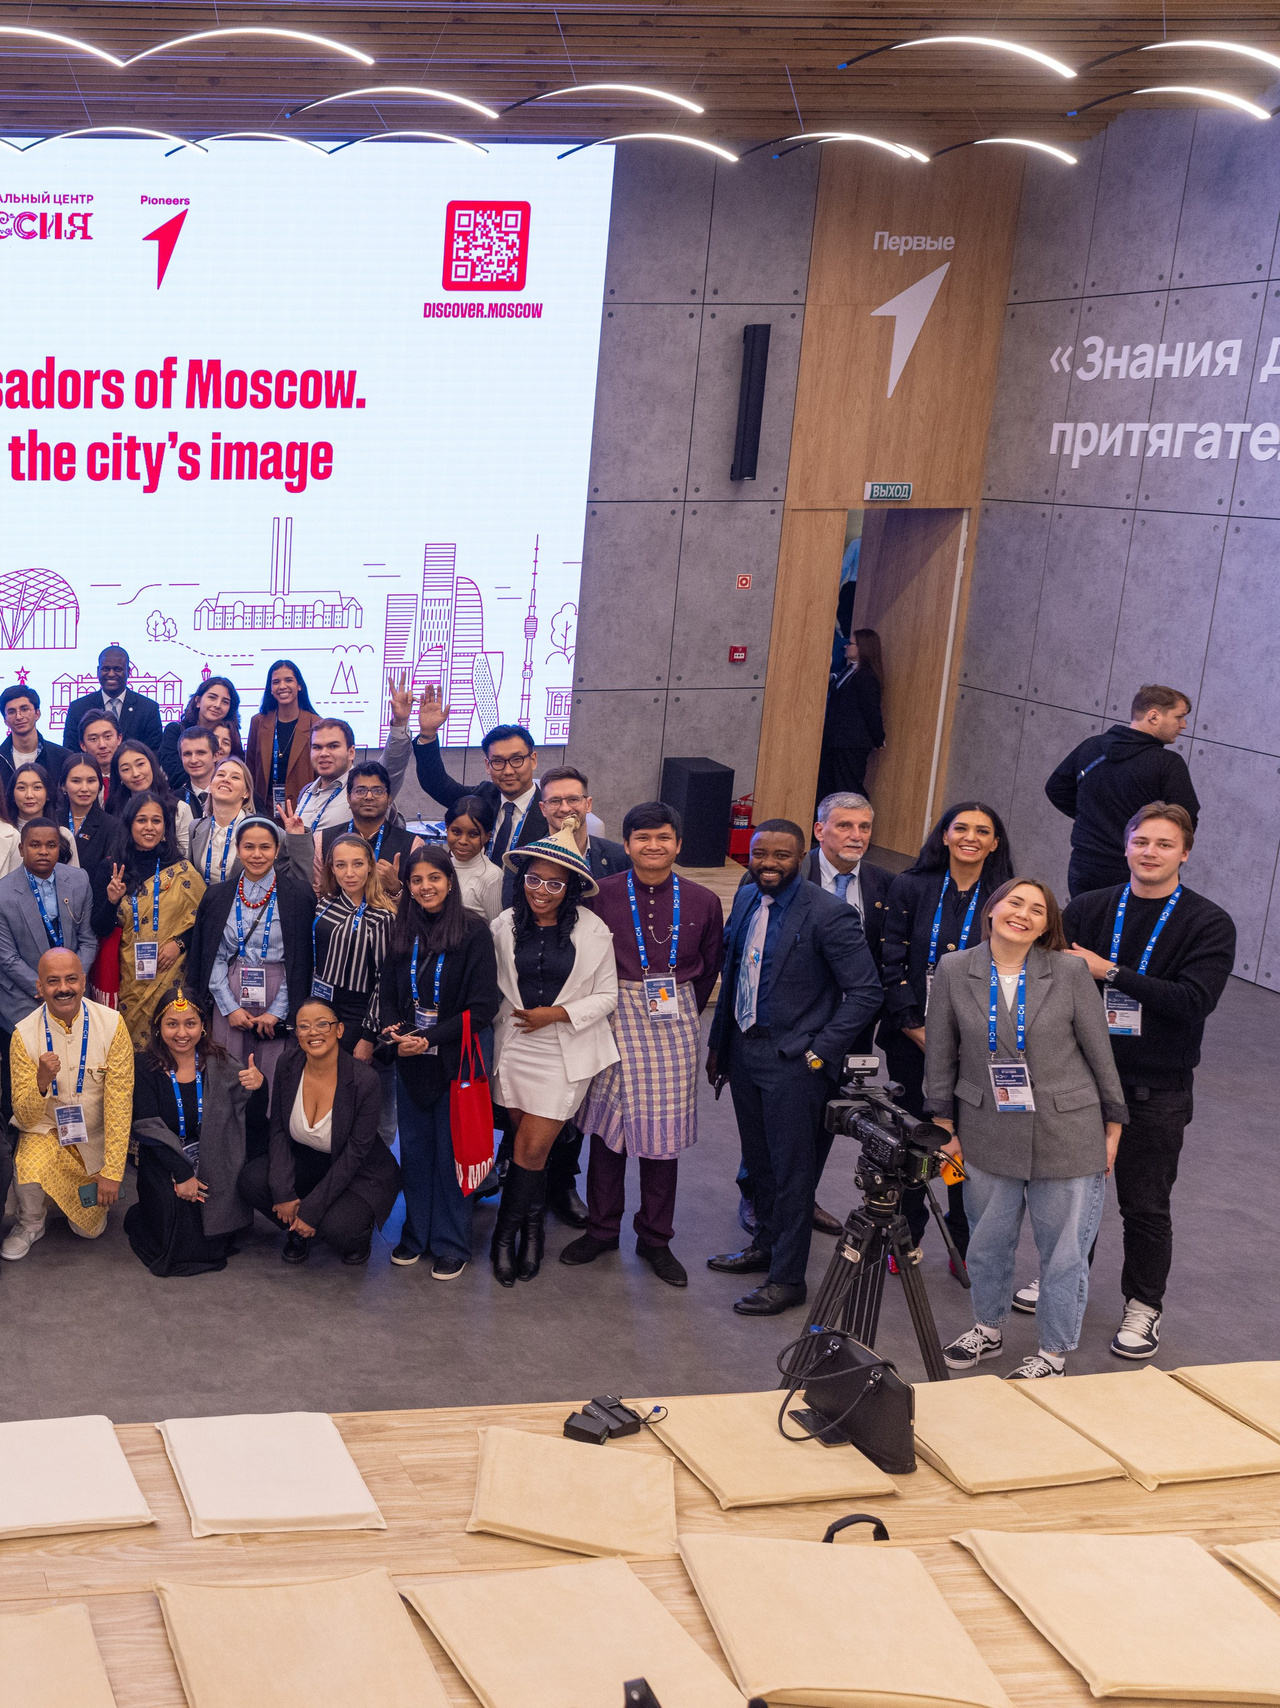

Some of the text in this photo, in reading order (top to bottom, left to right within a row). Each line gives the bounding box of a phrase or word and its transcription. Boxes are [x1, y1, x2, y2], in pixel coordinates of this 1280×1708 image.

[53, 193, 95, 206] ЦЕНТР
[140, 195, 191, 206] Pioneers
[873, 231, 956, 257] Первые
[135, 356, 178, 410] of
[186, 359, 367, 410] Moscow.
[1049, 422, 1280, 469] притягате
[8, 429, 77, 482] the
[211, 432, 334, 494] image
[872, 484, 909, 499] ВЫХОД
